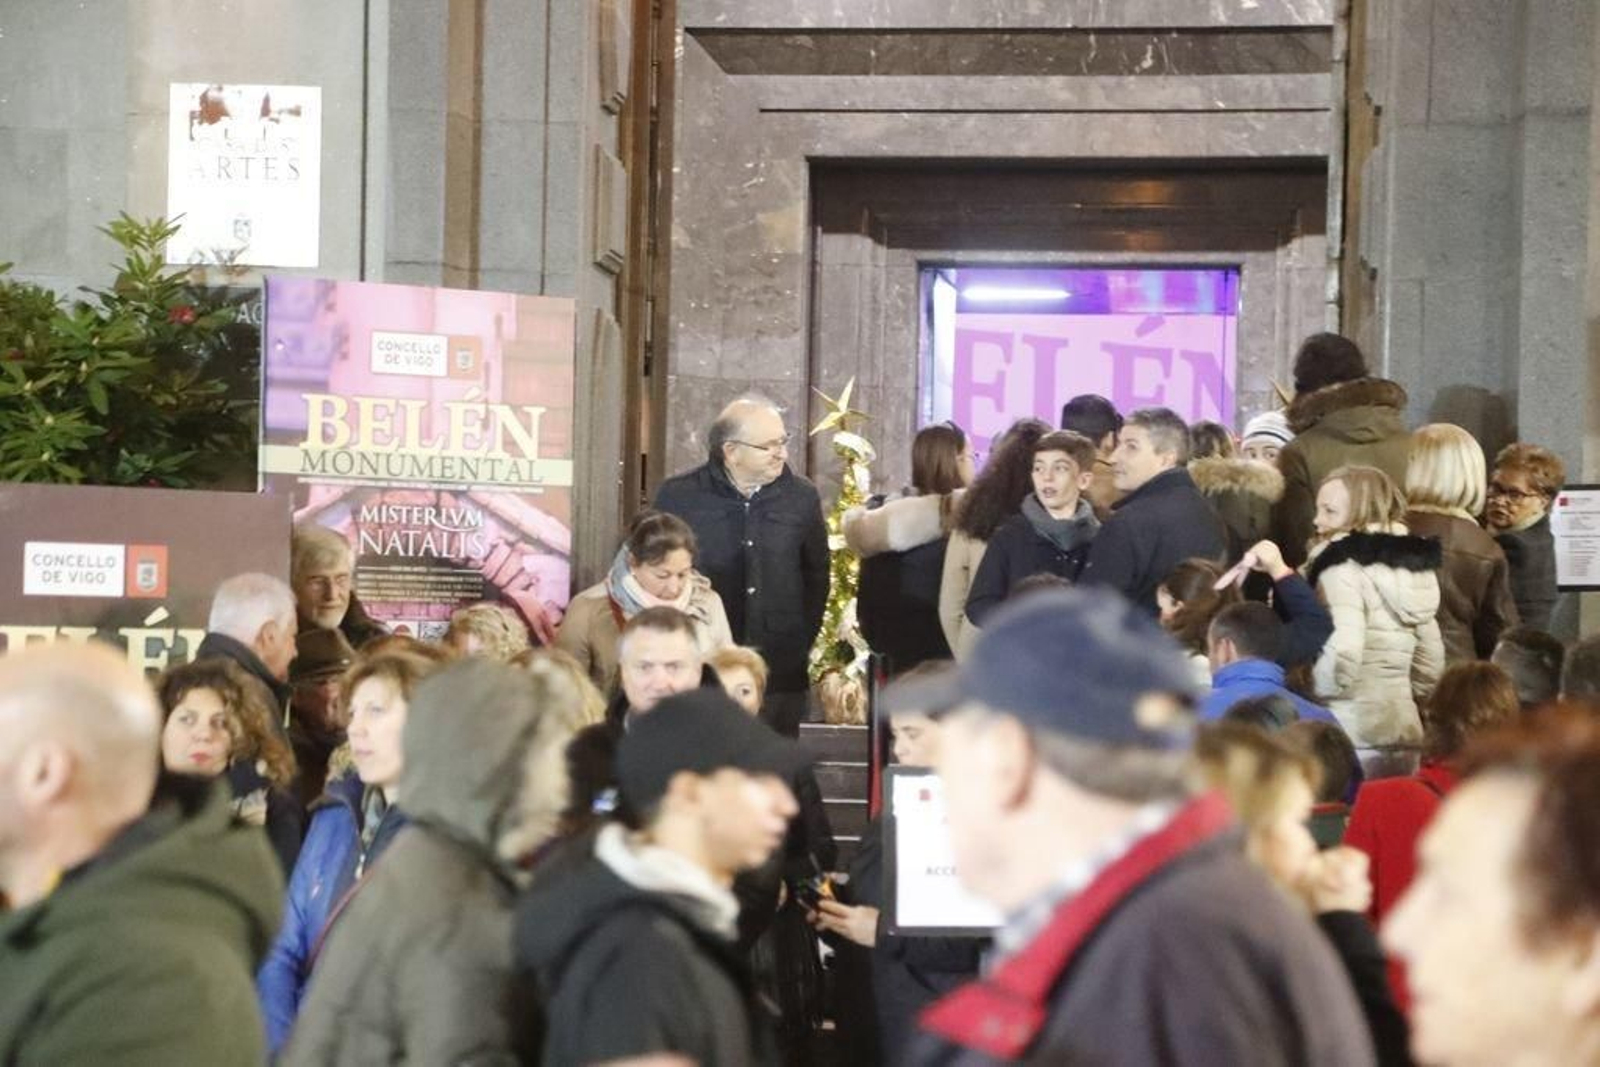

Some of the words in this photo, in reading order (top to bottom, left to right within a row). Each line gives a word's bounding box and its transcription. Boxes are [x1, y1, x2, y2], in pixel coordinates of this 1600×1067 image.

[376, 339, 442, 356] CONCELLO
[384, 352, 401, 366] DE
[404, 354, 435, 368] VIGO
[298, 387, 548, 460] BELÉN
[299, 448, 545, 484] MONUMENTAL
[358, 529, 487, 560] NATALIS
[31, 553, 118, 569] CONCELLO
[41, 569, 63, 583] DE
[70, 570, 108, 585] VIGO
